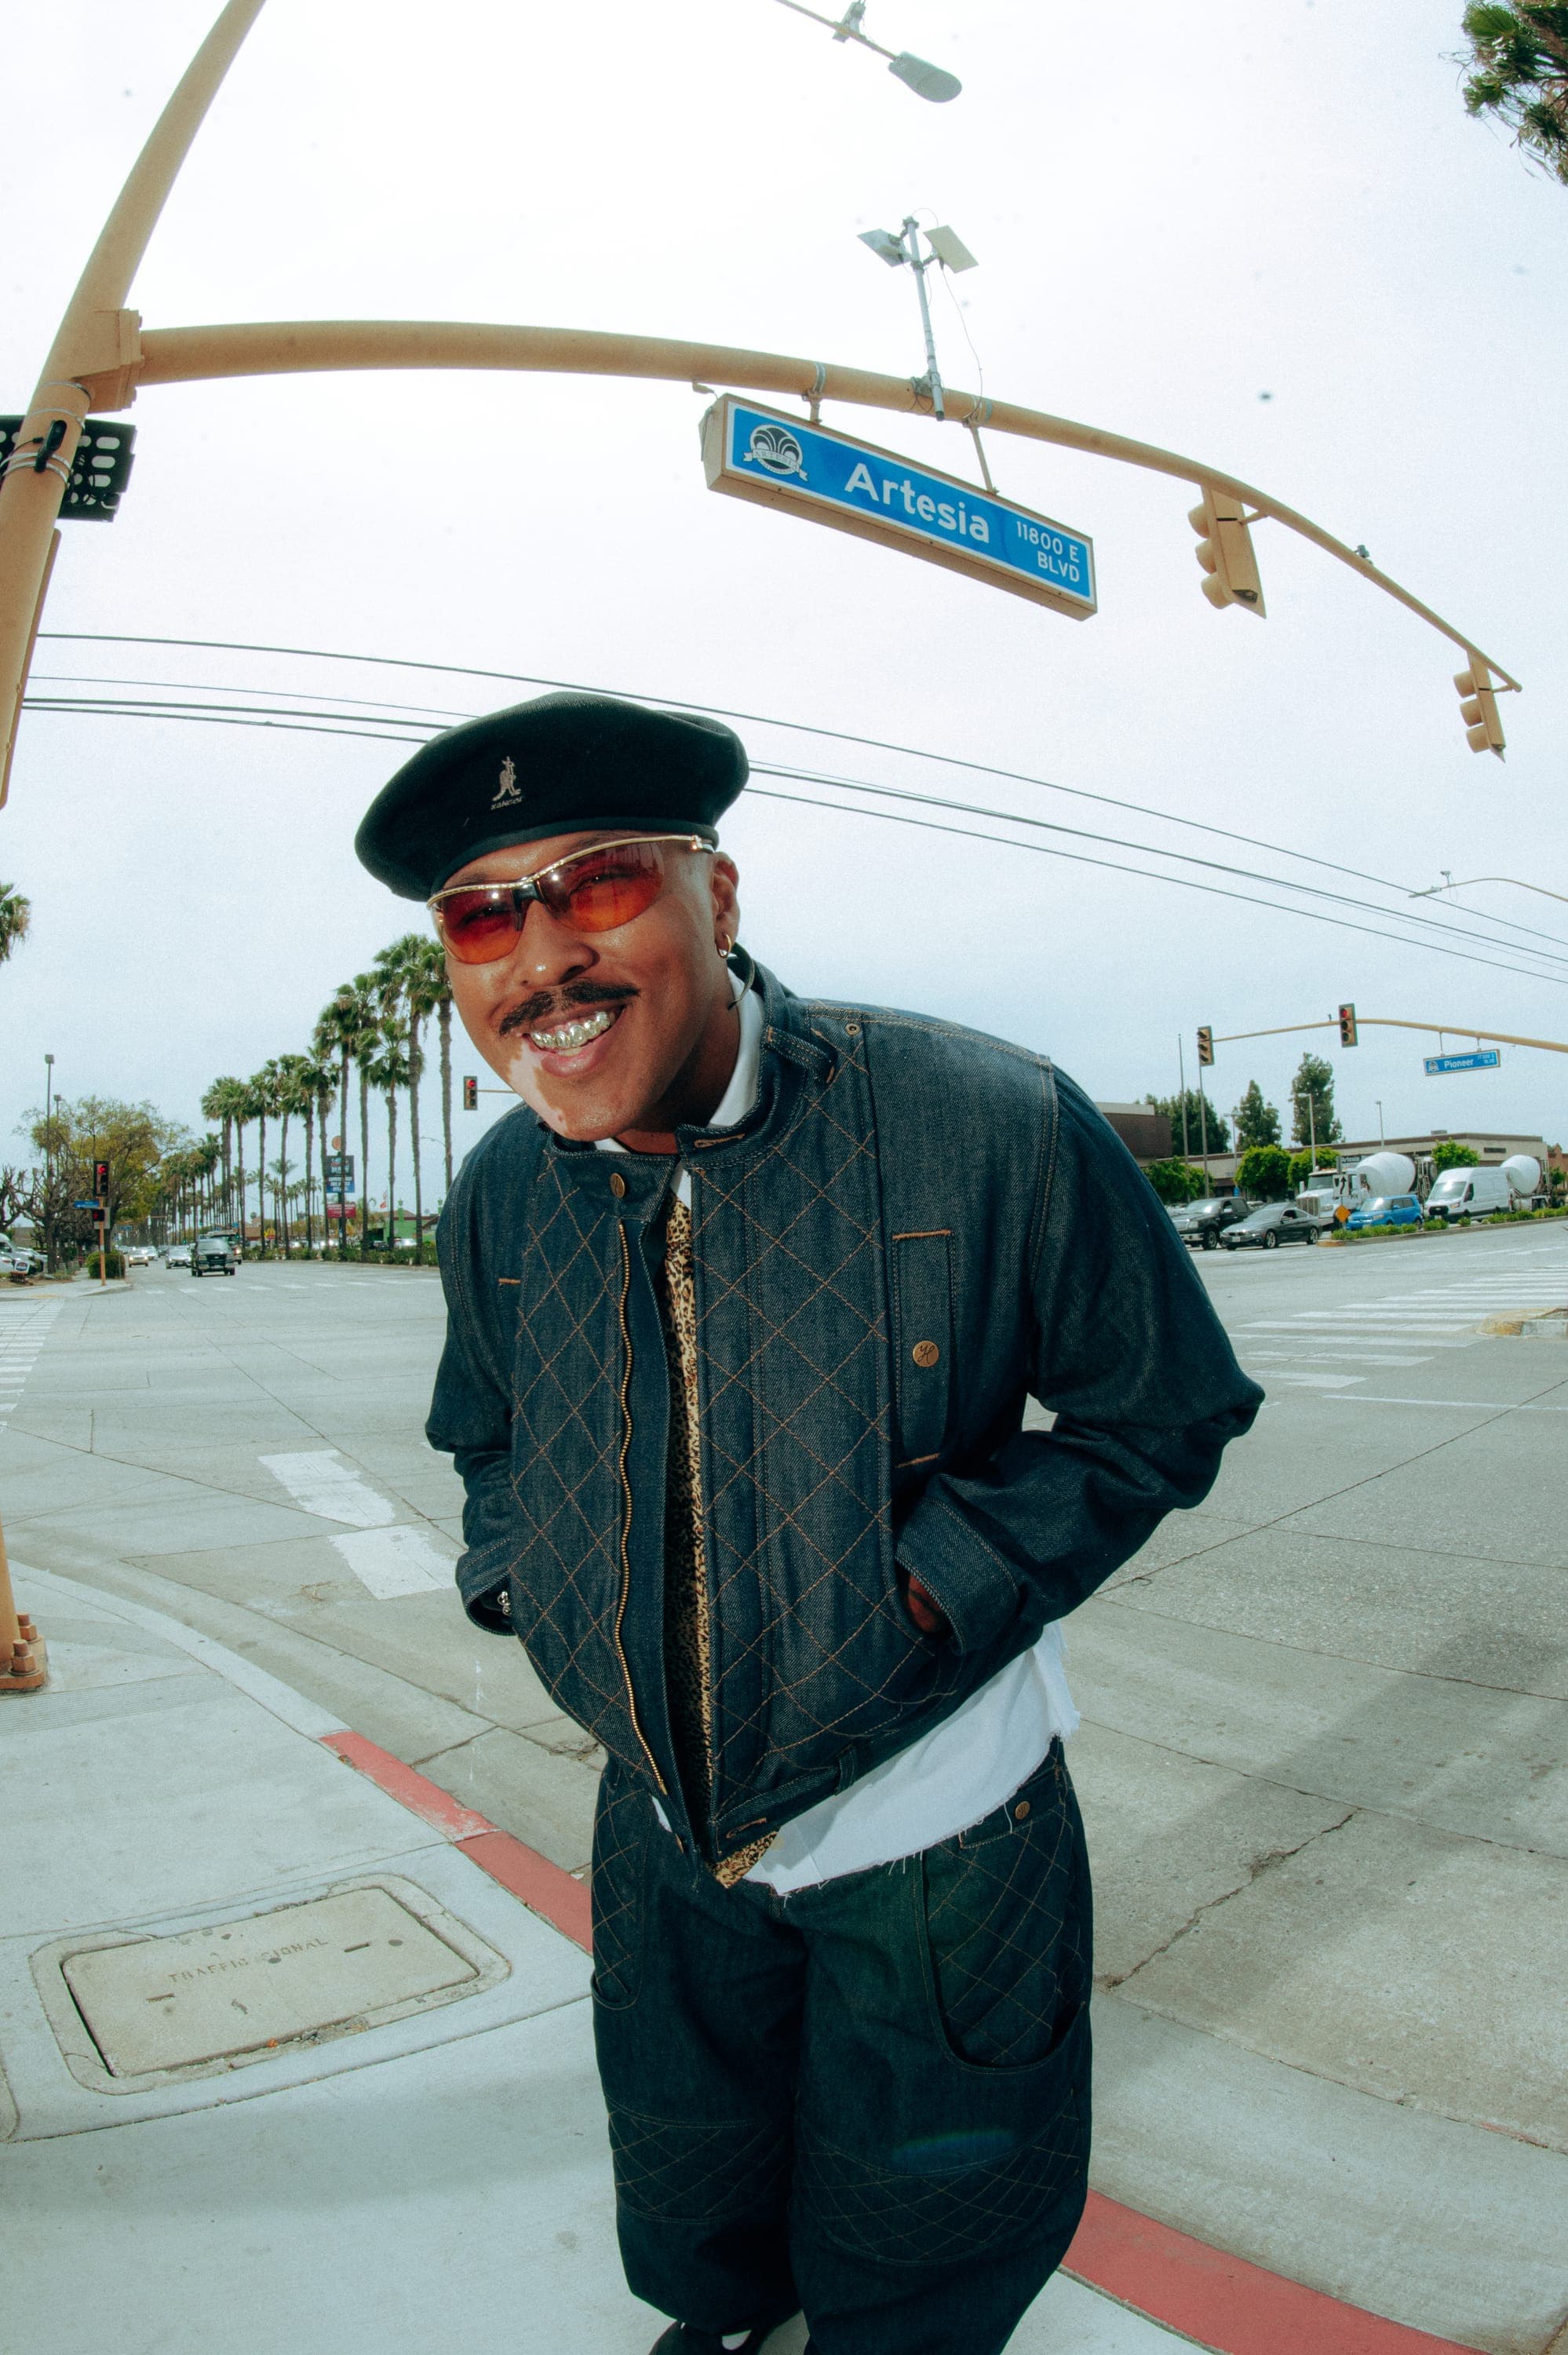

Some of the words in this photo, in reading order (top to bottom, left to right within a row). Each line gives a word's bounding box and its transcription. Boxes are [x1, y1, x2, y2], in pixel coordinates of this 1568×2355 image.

[844, 462, 990, 544] Artesia
[1016, 520, 1063, 555] 11800
[1069, 544, 1080, 564] E
[1037, 550, 1080, 582] BLVD
[1444, 1058, 1475, 1068] Pioneer
